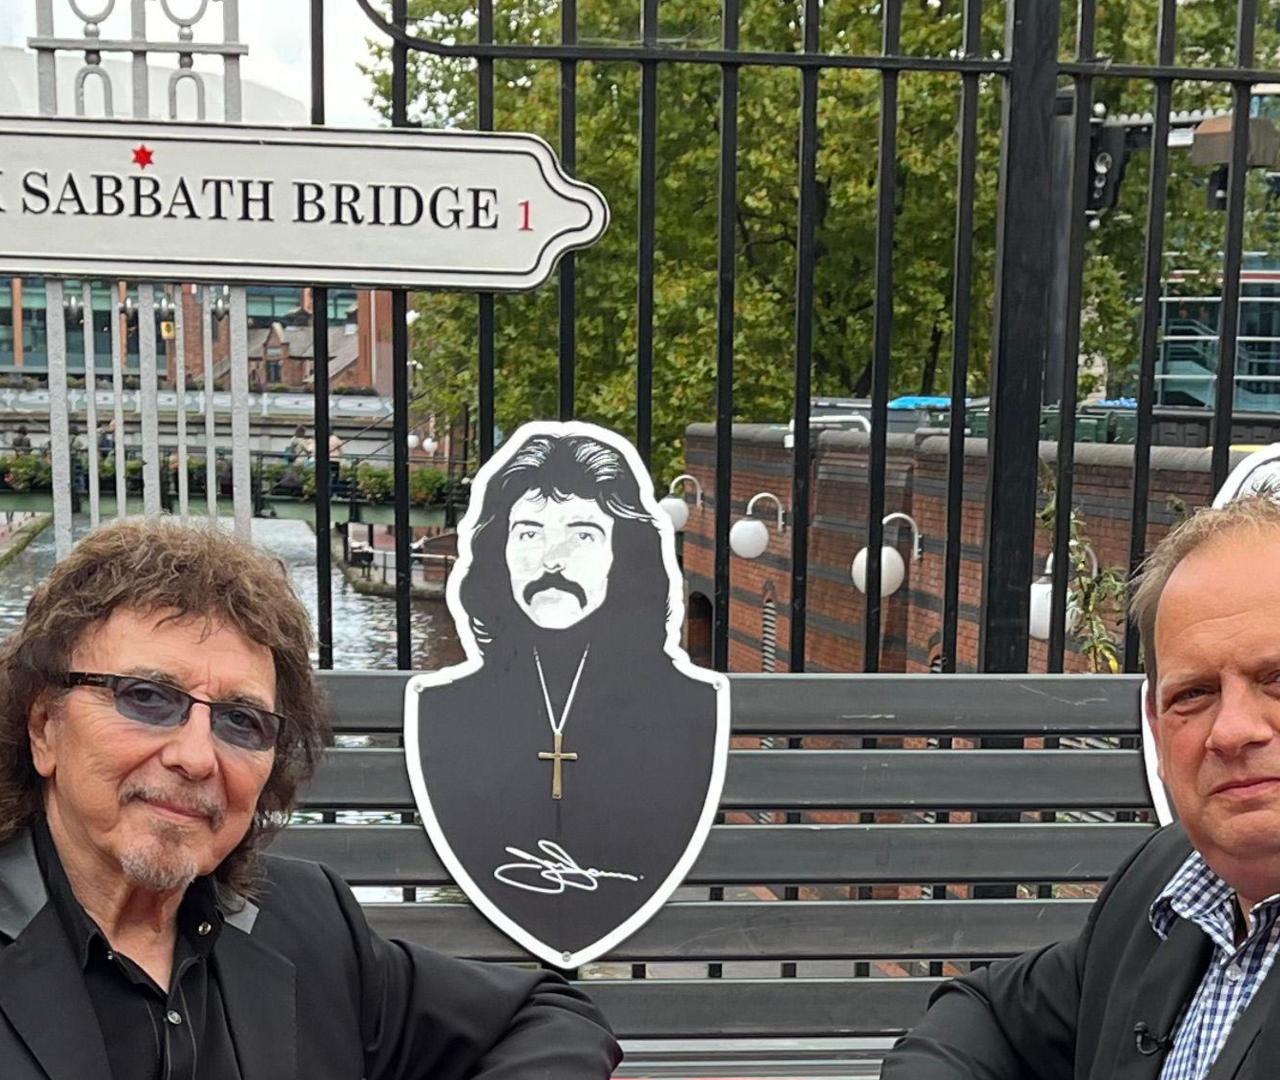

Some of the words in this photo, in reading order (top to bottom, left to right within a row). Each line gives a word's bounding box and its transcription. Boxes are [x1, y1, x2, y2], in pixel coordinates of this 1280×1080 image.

[22, 171, 274, 222] SABBATH
[291, 182, 500, 231] BRIDGE
[517, 199, 535, 233] 1
